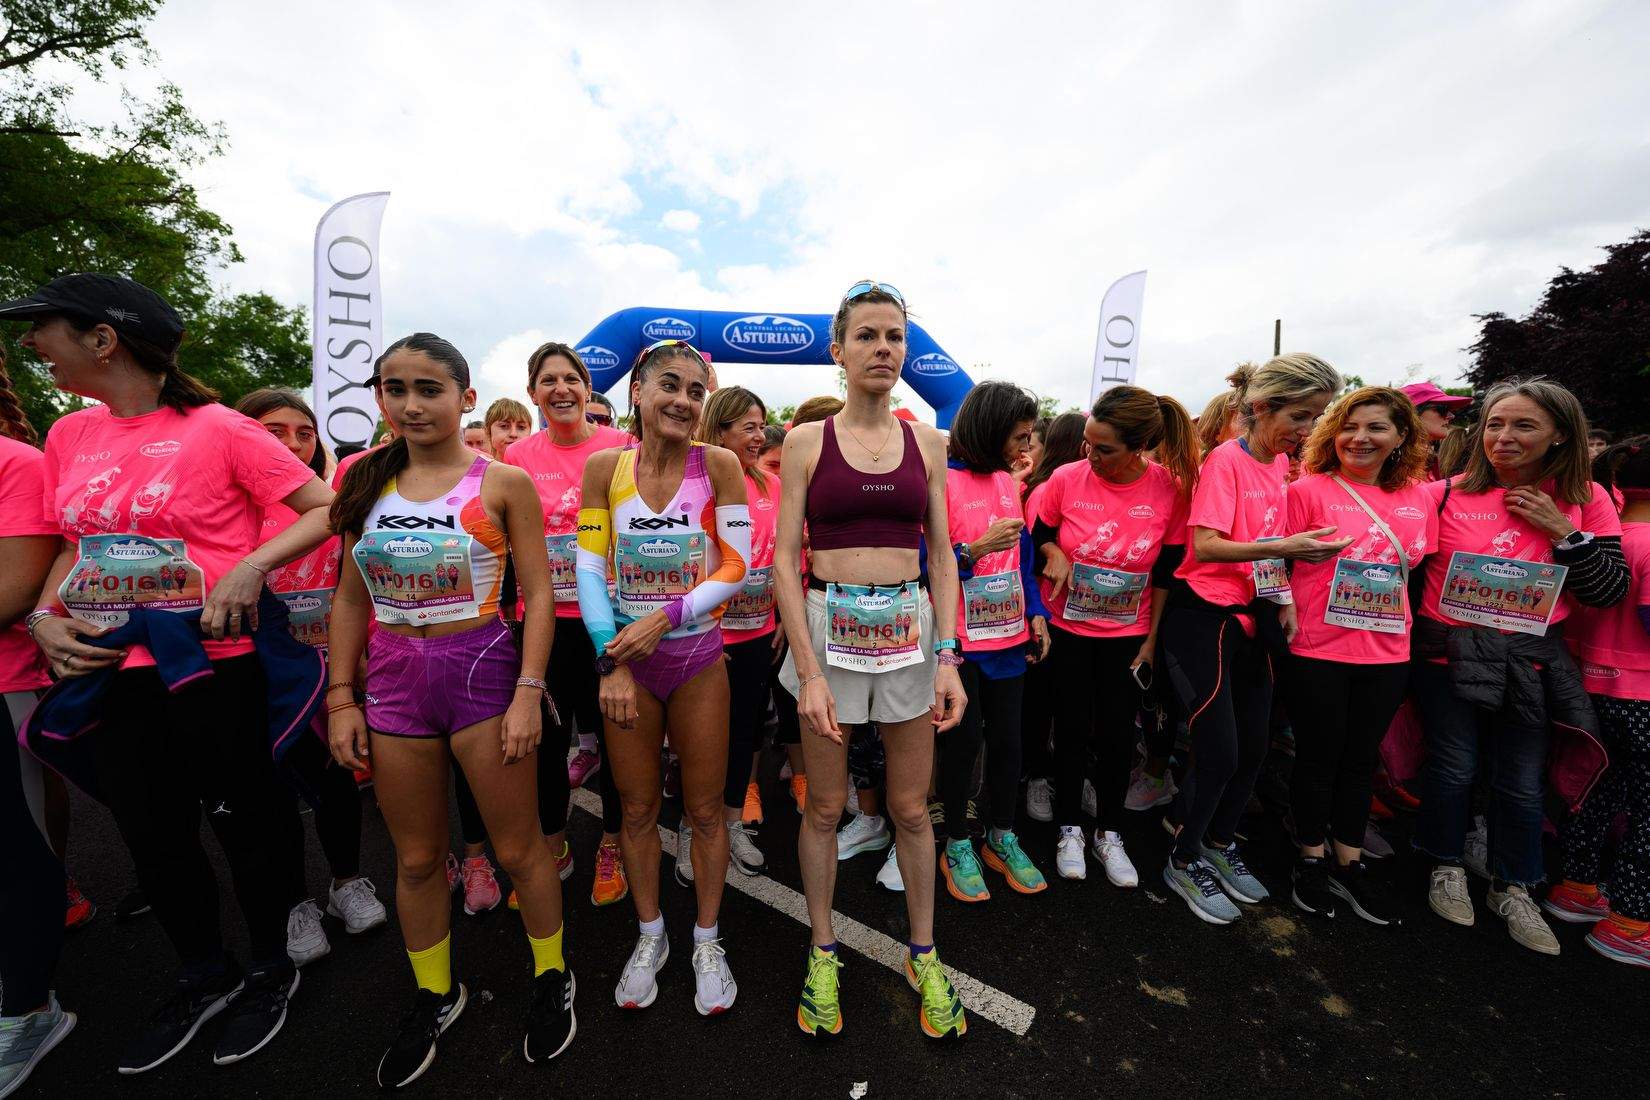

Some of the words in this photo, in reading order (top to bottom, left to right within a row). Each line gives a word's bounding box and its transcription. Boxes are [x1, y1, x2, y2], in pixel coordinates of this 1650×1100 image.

[647, 325, 692, 337] ASTURIANA
[730, 325, 807, 345] ASTURIANA
[327, 235, 374, 447] OYSHO
[582, 356, 616, 365] TURIANA
[915, 361, 956, 371] ASTURIANA
[1073, 501, 1105, 511] OYSHO
[1453, 512, 1498, 521] OYSHO
[107, 546, 157, 557] ASTURIANA
[386, 544, 431, 553] ASTURIANA
[641, 546, 679, 554] ASTURIANA
[1484, 565, 1526, 577] ASTURIANA
[393, 573, 434, 589] 016
[643, 570, 681, 584] 016
[102, 575, 157, 593] 016
[406, 593, 417, 601] 14
[1362, 591, 1391, 605] 016
[1478, 586, 1519, 602] 016
[82, 611, 119, 622] OYSHO
[427, 608, 465, 618] Santander
[1448, 608, 1481, 620] OYSHO
[1335, 616, 1365, 624] OYSHO
[1501, 619, 1533, 629] Santander
[858, 623, 894, 638] 016
[836, 655, 867, 665] OYSHO
